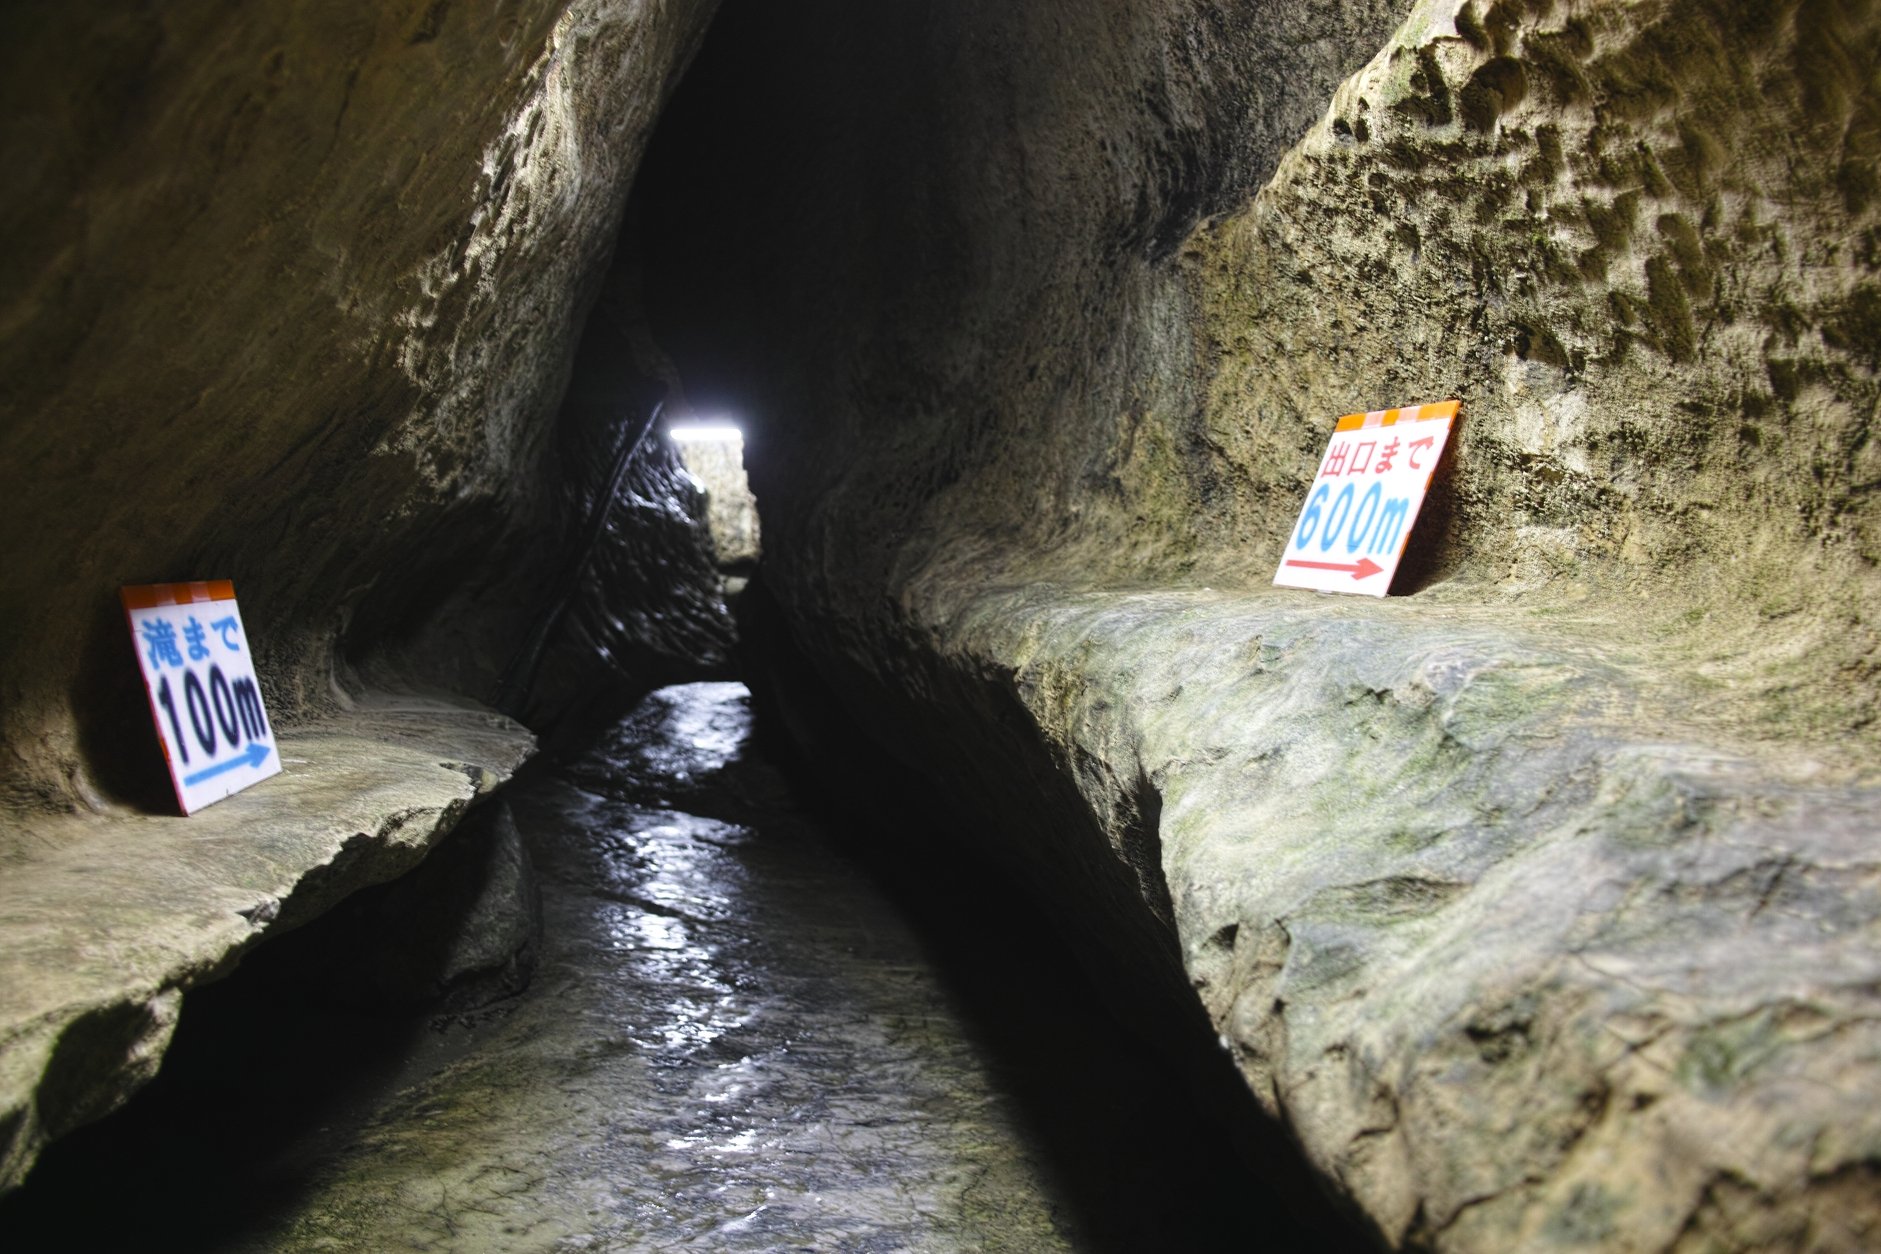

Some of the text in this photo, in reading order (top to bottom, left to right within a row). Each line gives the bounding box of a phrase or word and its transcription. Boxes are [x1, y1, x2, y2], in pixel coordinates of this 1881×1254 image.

[1320, 436, 1434, 478] 出口まで
[1295, 480, 1409, 555] 600m
[142, 615, 240, 670] 滝まで
[157, 662, 266, 766] 100m
